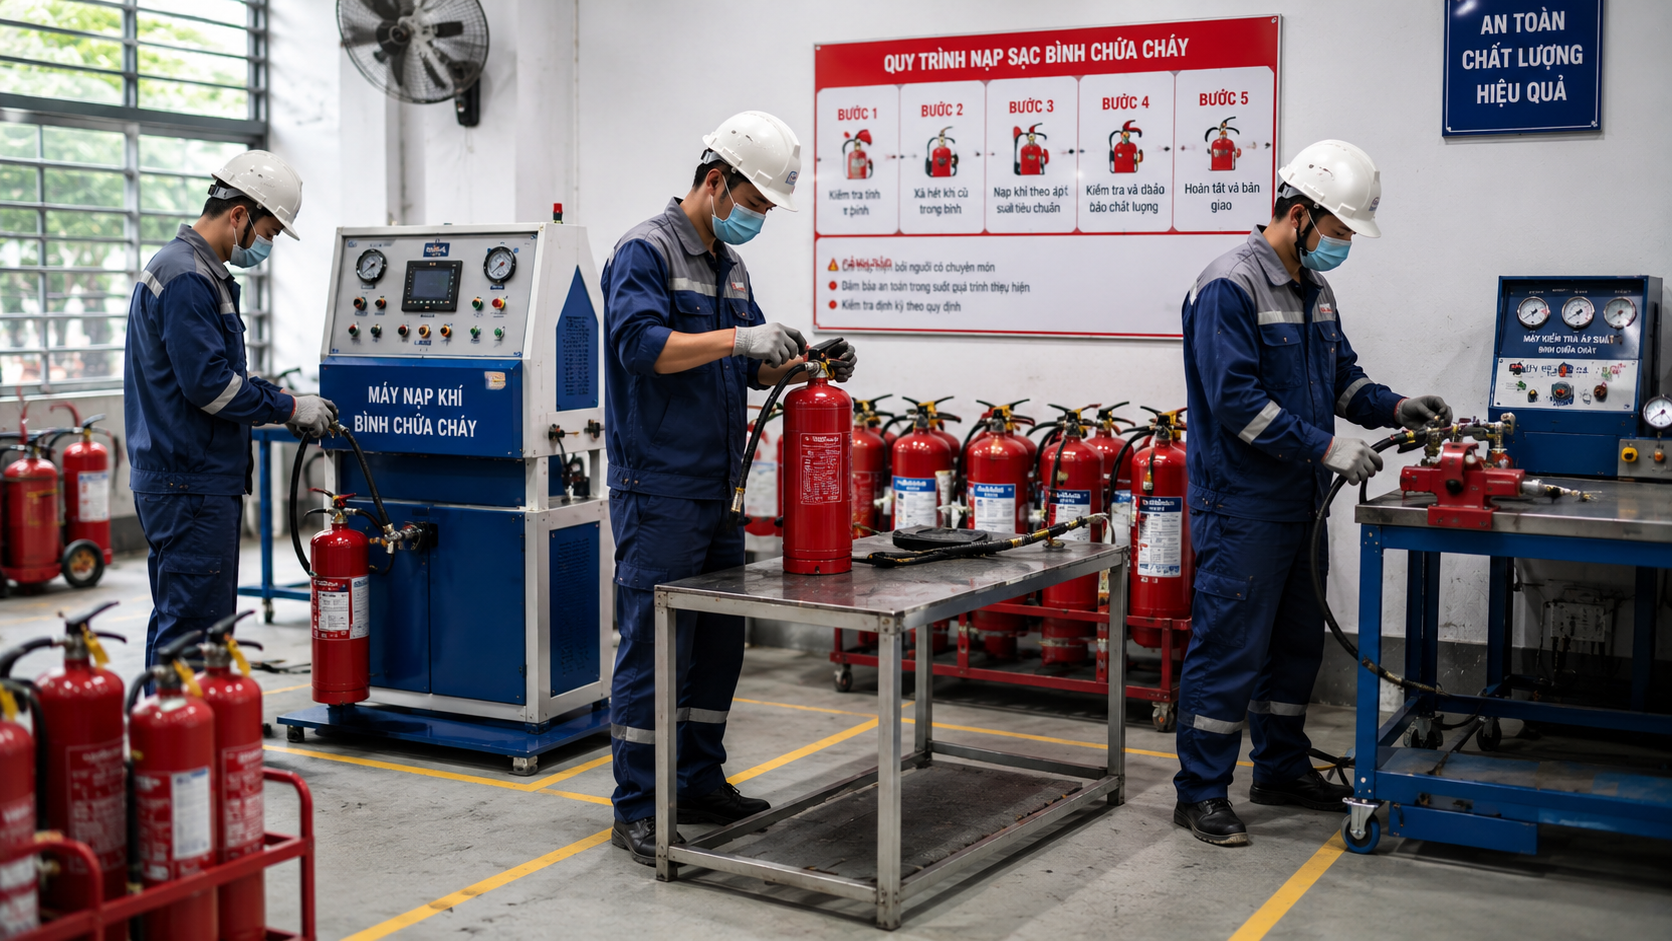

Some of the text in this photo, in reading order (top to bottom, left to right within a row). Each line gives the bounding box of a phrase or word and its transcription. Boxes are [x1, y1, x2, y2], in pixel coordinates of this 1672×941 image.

[1480, 6, 1565, 35] AN TOÀN
[884, 53, 915, 74] QUY
[918, 47, 966, 71] TRÌNH
[970, 48, 1004, 71] NẠP
[1007, 46, 1041, 70] SẠC
[1045, 40, 1085, 63] BÌNH
[1142, 33, 1189, 58] CHÁY
[1462, 42, 1583, 70] CHẤT LƯỢNG
[1241, 91, 1249, 105] 5
[1477, 75, 1567, 107] HIỆU QUẢ
[1046, 99, 1054, 113] 3
[1141, 95, 1150, 109] 4
[872, 107, 877, 119] 1
[956, 103, 963, 116] 2
[1112, 185, 1125, 195] tra
[1211, 199, 1232, 213] giao
[368, 382, 463, 409] MÁY NẠP KHÍ
[354, 411, 389, 433] BÌNH
[438, 415, 477, 438] CHÁY
